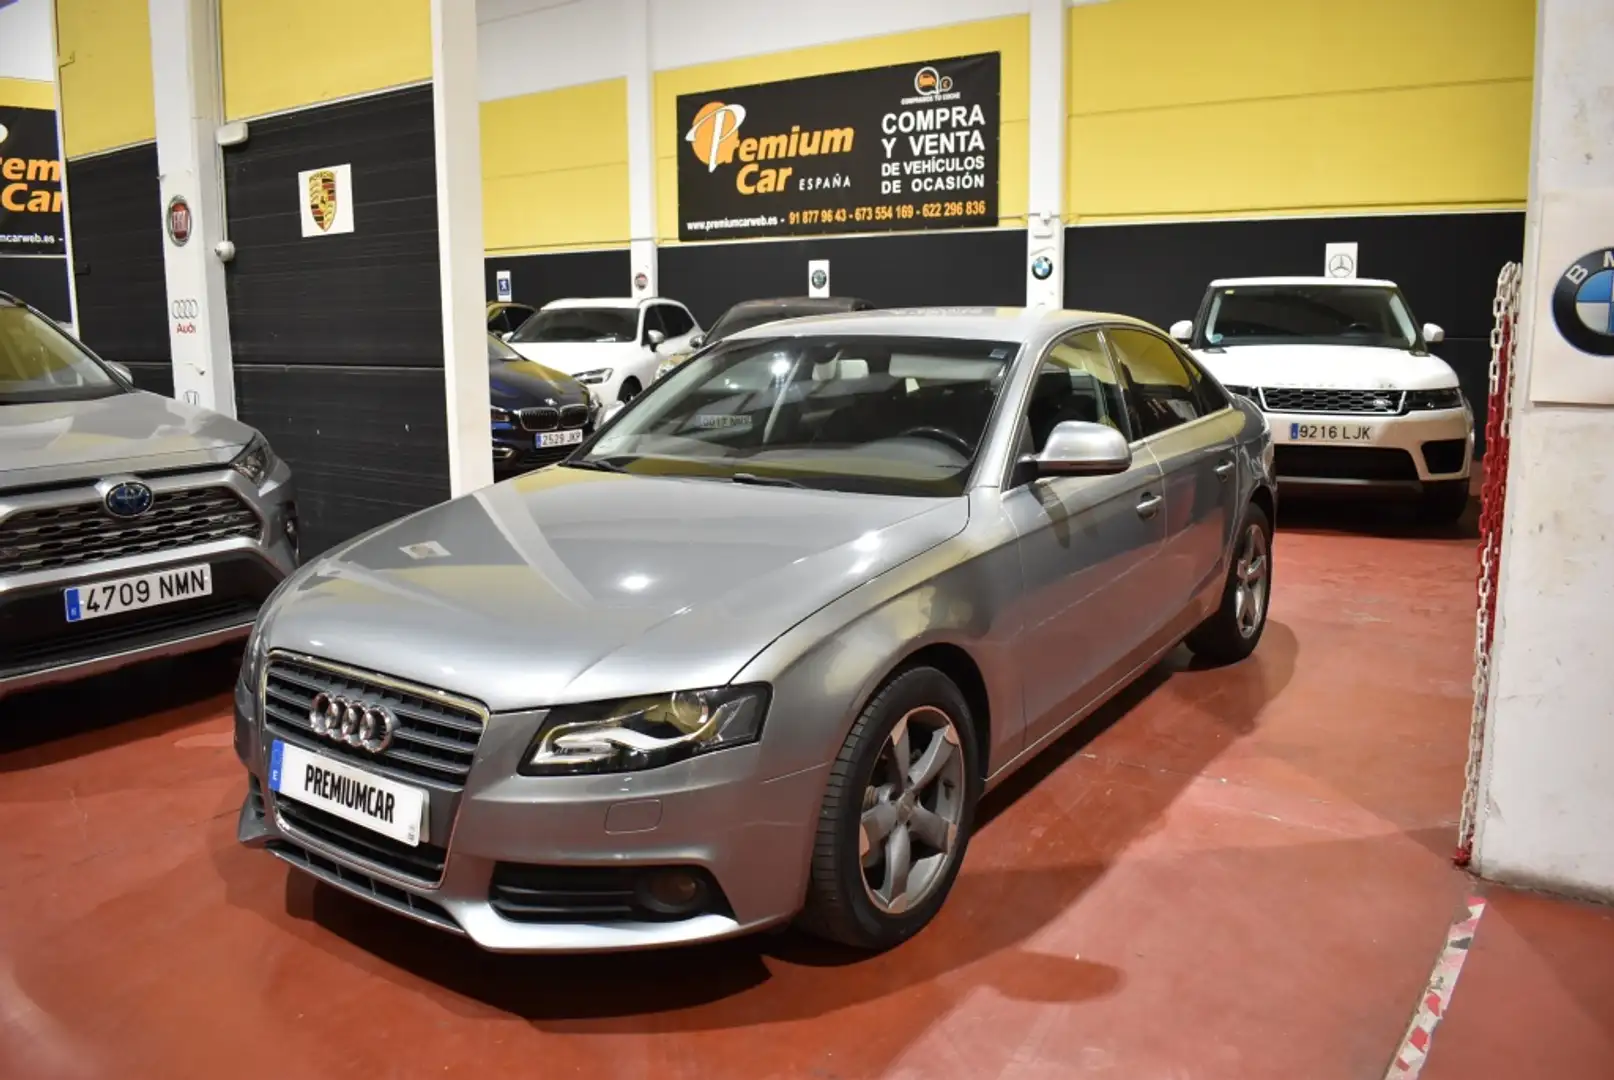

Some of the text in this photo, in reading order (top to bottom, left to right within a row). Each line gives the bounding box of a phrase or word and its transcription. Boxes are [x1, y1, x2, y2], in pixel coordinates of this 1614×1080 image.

[882, 104, 986, 135] COMPRA
[685, 103, 854, 173] Premium
[881, 130, 986, 159] Y VENTA
[736, 163, 851, 195] Car ESPAÑA
[882, 155, 985, 177] DE VEHÍCULOS
[881, 171, 985, 195] DE OCASIÓN
[687, 215, 778, 232] www.premiumcarweb.es
[789, 211, 799, 225] 91
[802, 209, 819, 224] 877
[821, 209, 833, 223] 96
[835, 208, 846, 222] 43
[855, 206, 873, 221] 673
[875, 205, 893, 220] 554
[895, 204, 914, 219] 169
[922, 202, 941, 217] 622
[944, 201, 963, 217] 296
[965, 200, 986, 215] 836
[176, 322, 197, 334] Audi
[1300, 425, 1371, 440] 9216 LJK
[86, 569, 205, 612] 4709 NMN
[304, 763, 396, 824] PREMIUMCAR
